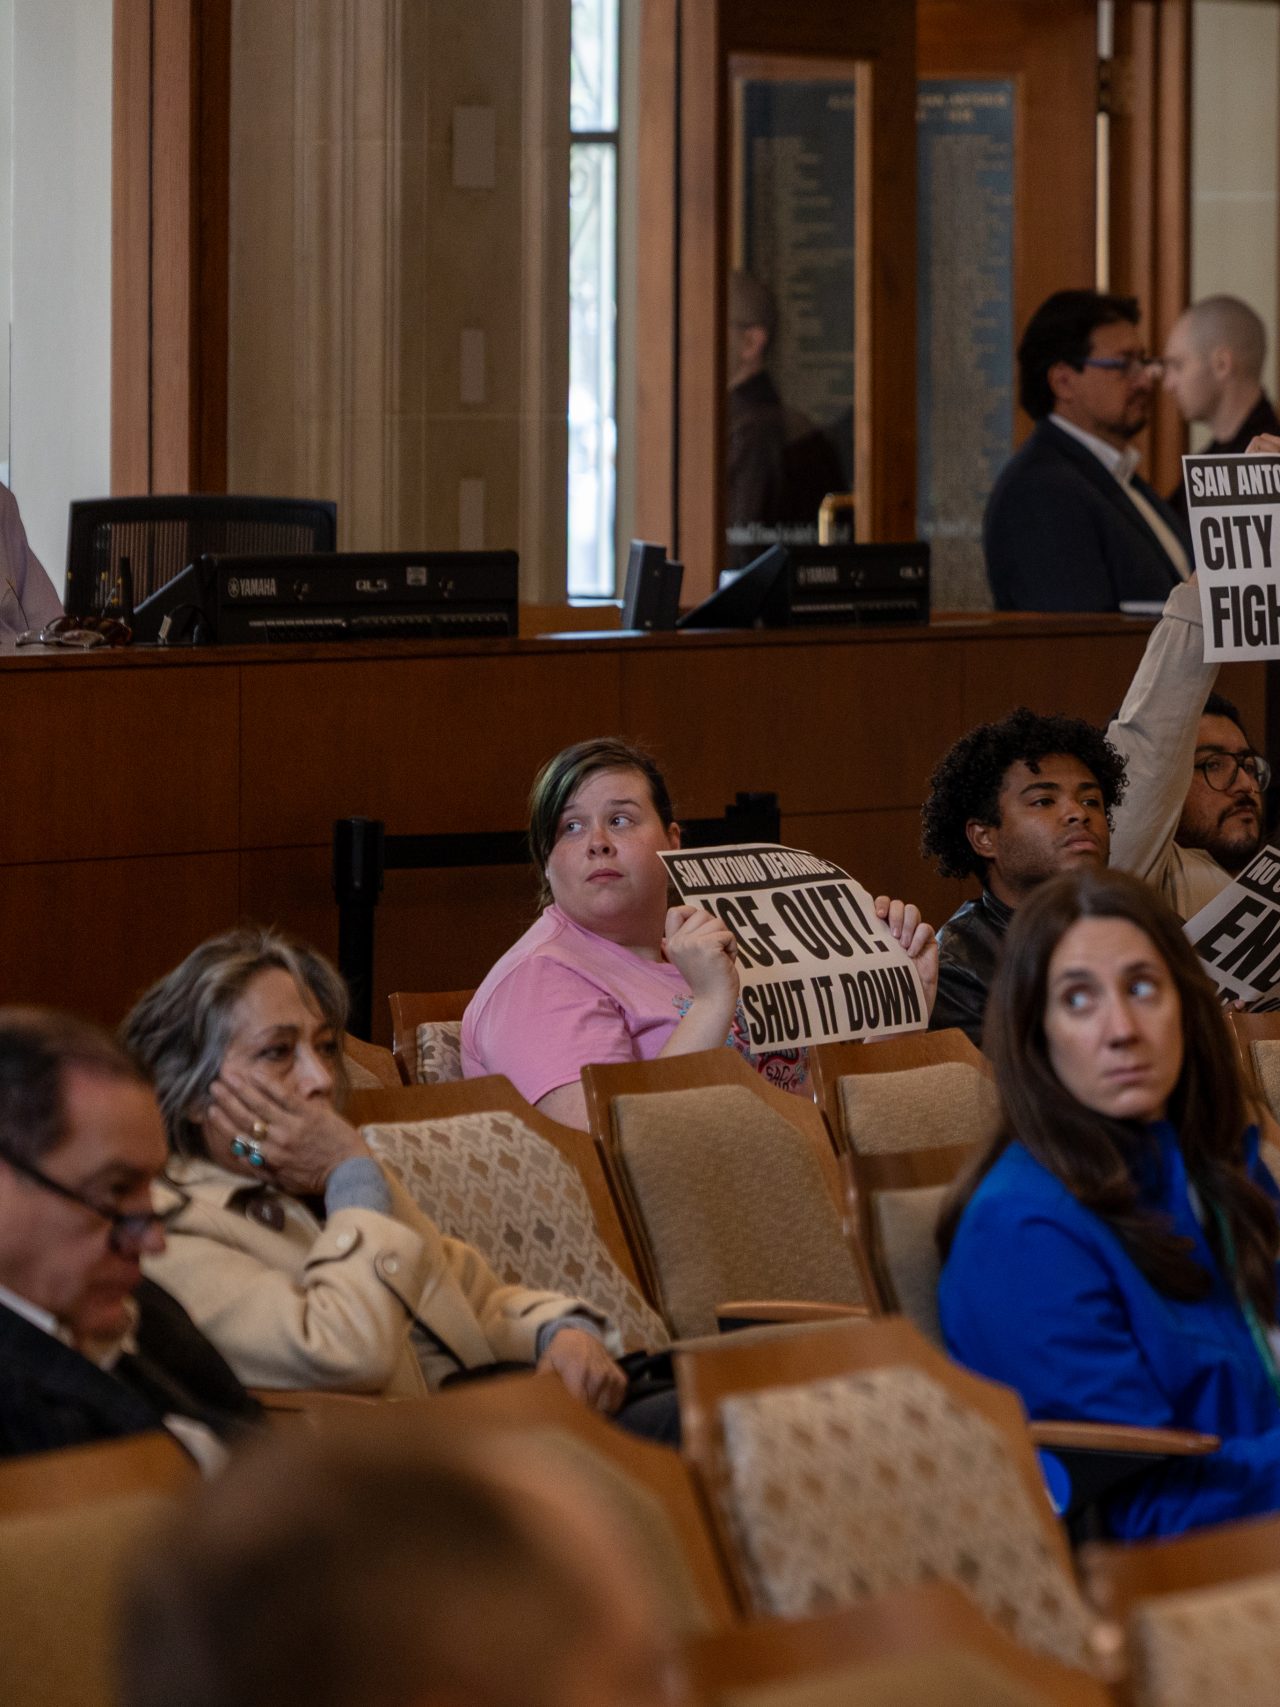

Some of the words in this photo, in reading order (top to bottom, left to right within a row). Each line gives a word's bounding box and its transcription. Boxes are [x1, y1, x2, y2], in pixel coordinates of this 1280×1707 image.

[1190, 466, 1232, 498] SAN
[1200, 514, 1273, 571] CITY
[239, 577, 277, 597] YAMAHA
[673, 857, 707, 889] SAN
[706, 854, 766, 886] ANTONIO
[771, 883, 891, 961] OUT!
[742, 979, 813, 1046] SHUT
[810, 975, 839, 1036] IT
[838, 965, 922, 1032] DOWN
